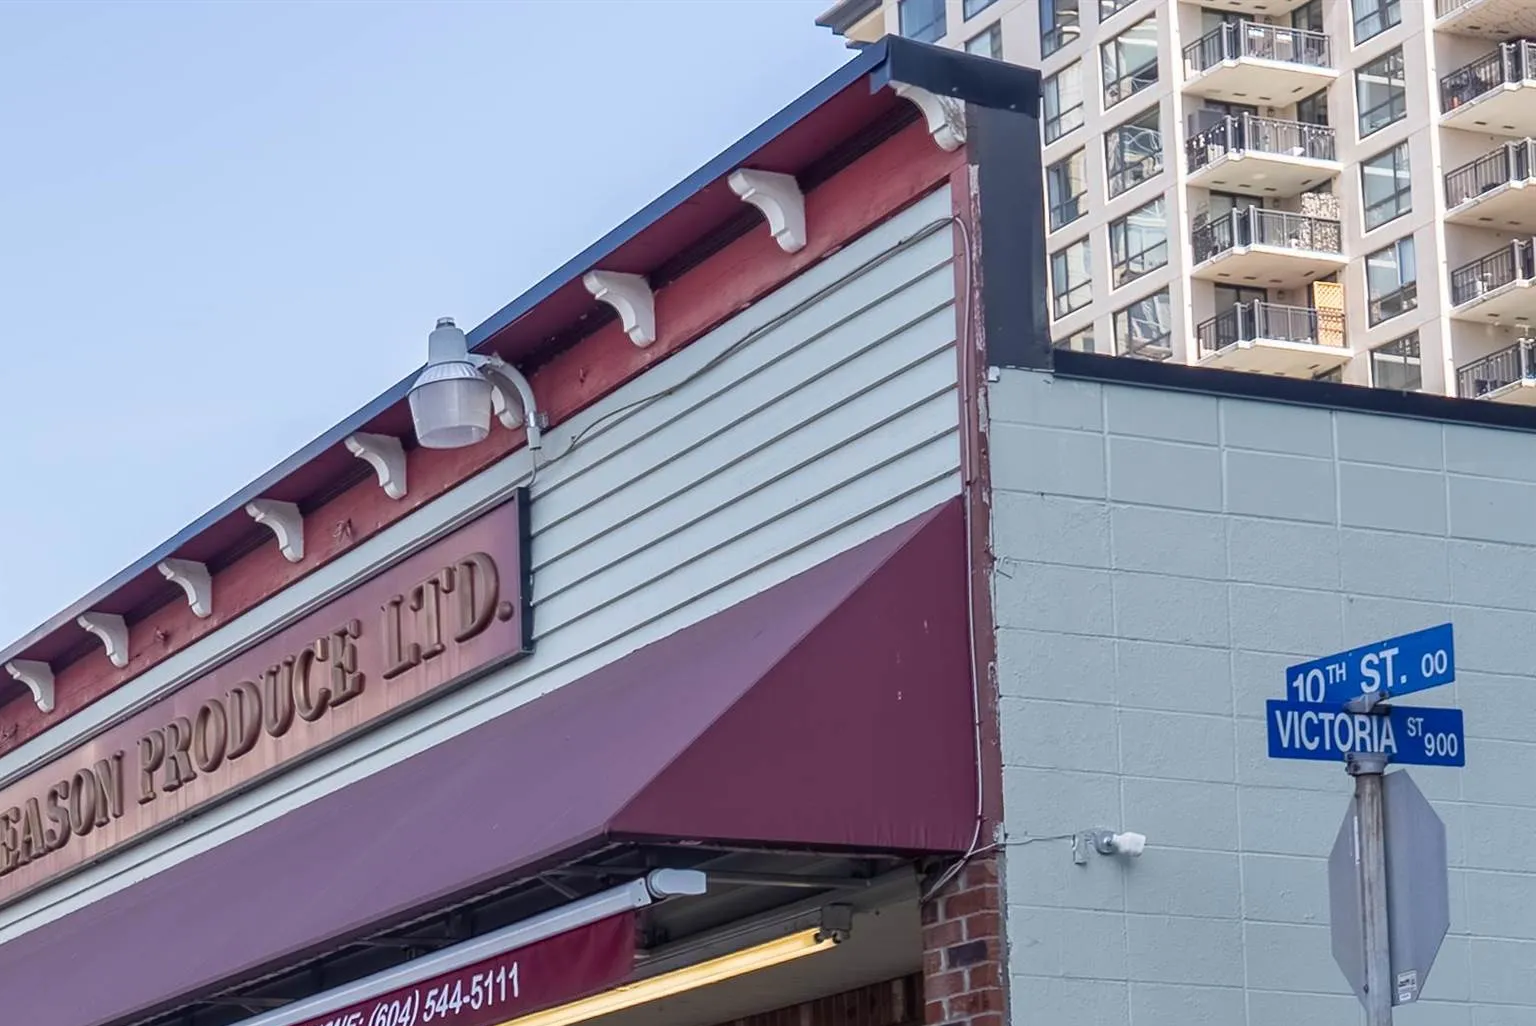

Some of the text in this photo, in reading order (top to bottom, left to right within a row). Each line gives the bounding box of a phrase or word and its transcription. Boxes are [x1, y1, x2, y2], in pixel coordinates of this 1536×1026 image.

[136, 619, 364, 805] PRODUCE
[382, 551, 514, 680] LTD.
[1292, 662, 1347, 703] 10TH
[1360, 648, 1407, 693] ST.
[1275, 709, 1458, 758] VICTORIA ST 900
[423, 961, 520, 1023] 544-5111
